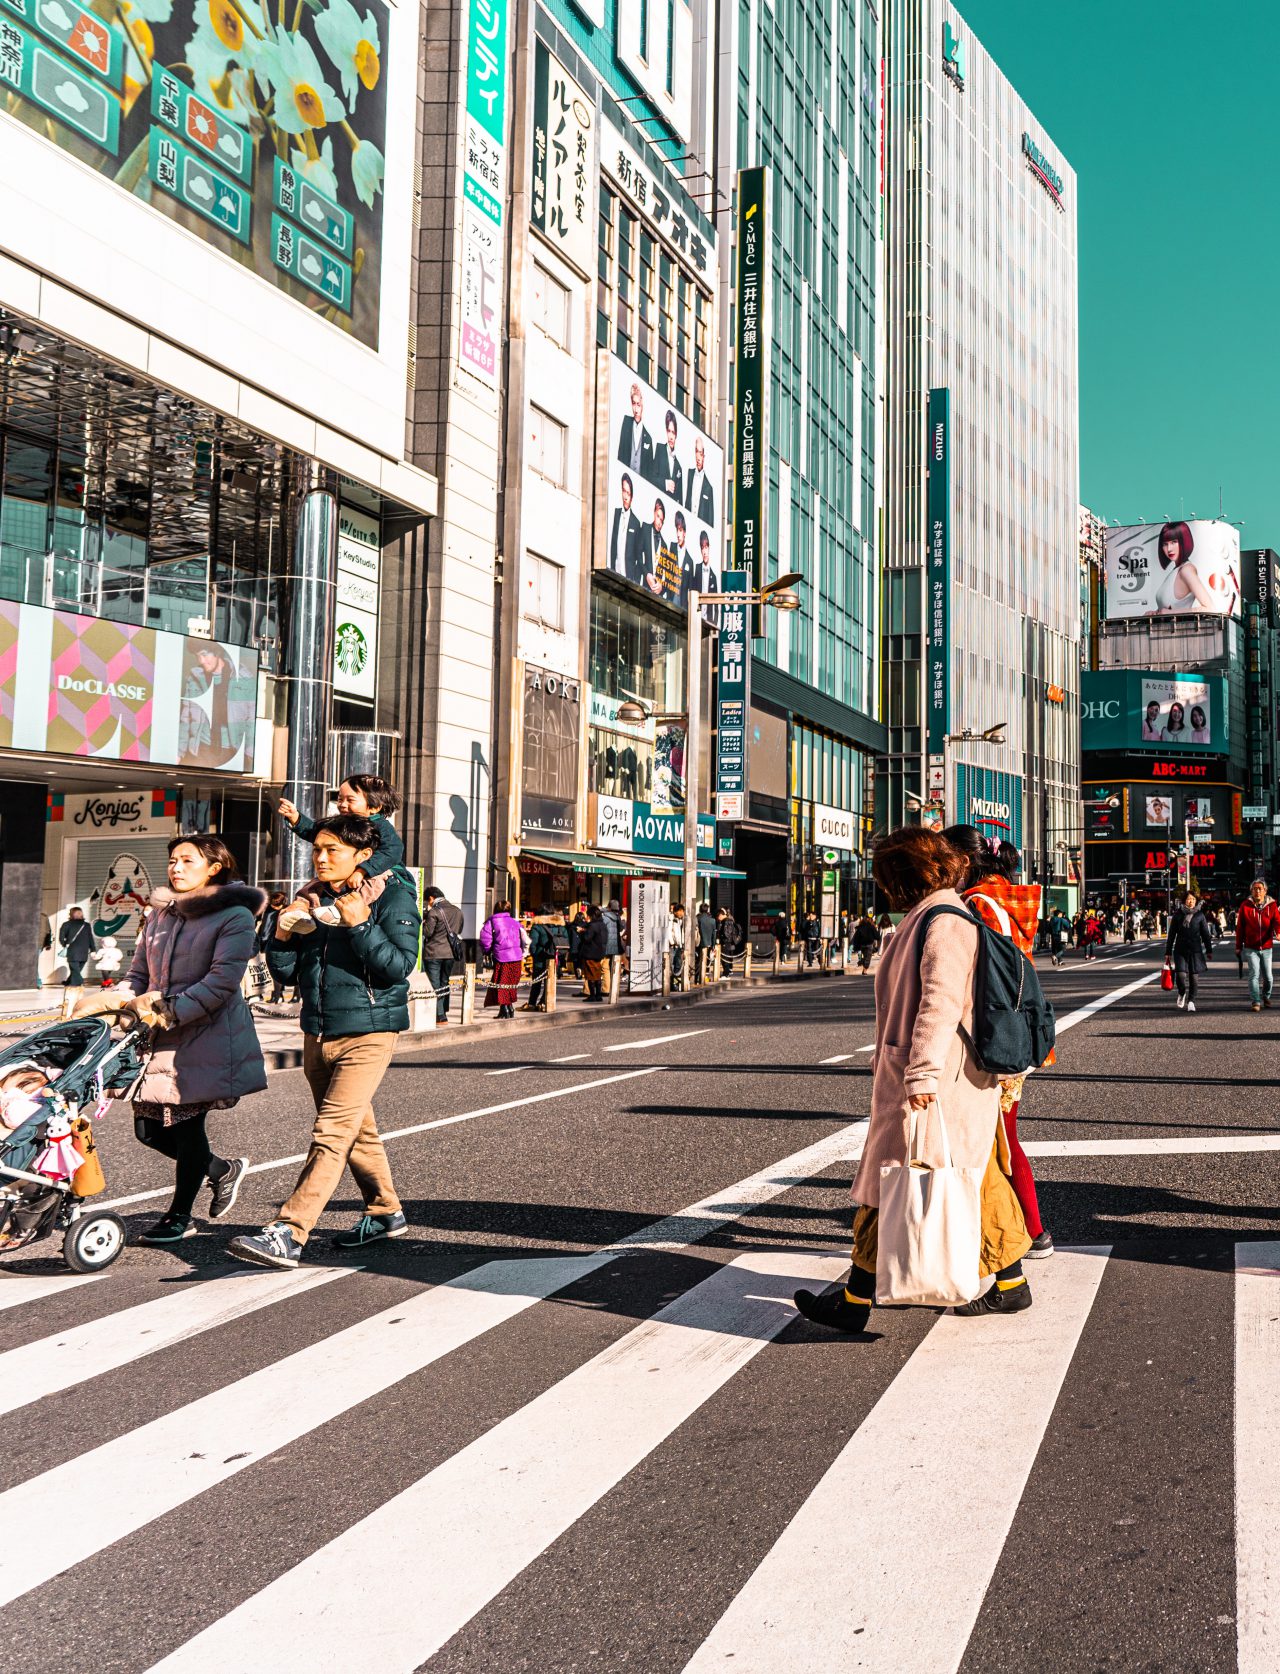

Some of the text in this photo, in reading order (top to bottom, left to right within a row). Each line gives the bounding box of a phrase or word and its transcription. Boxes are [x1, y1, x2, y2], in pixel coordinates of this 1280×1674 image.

[0, 23, 21, 85] 神奈川
[161, 77, 178, 127] 千葉
[159, 141, 176, 189] 山梨
[468, 149, 499, 191] 新宿店
[551, 80, 570, 238] ルノアール
[281, 166, 294, 212] 静岡
[278, 225, 291, 266] 長野
[743, 222, 758, 359] SMBC 三井住友銀行
[935, 423, 943, 461] MIZUHO
[343, 550, 376, 570] KeyStudio
[932, 521, 943, 566] みずほ証券
[1258, 550, 1266, 564] THE
[1116, 571, 1150, 579] treatment
[1118, 553, 1148, 573] Spa
[1258, 567, 1267, 584] SUIT
[932, 582, 943, 646] みずほ信託銀行
[722, 590, 744, 683] 洋服の青山
[57, 674, 146, 701] DoCLASSE
[532, 673, 580, 702] AOKI
[932, 662, 943, 708] みずほ銀行
[1153, 763, 1207, 776] ABC-MART
[74, 799, 140, 827] Konjac
[972, 798, 1010, 818] MIZUHO
[599, 822, 630, 840] ルノアール
[821, 818, 849, 838] GUCCI
